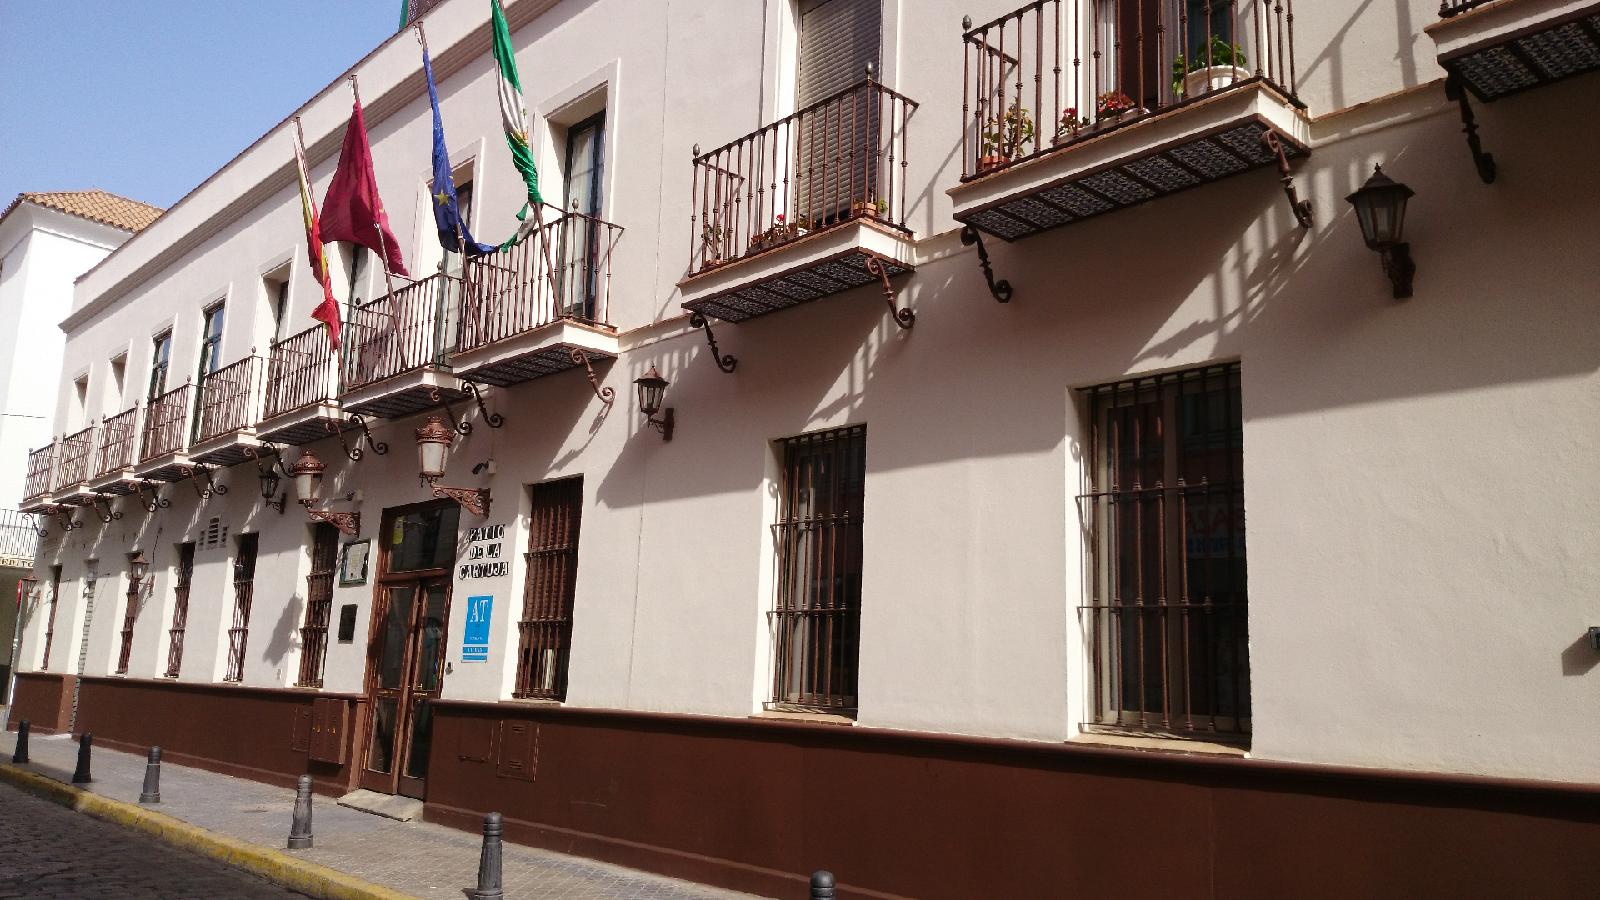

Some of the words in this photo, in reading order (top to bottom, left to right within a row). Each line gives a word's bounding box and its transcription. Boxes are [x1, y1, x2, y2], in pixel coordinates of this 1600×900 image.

[469, 525, 505, 542] PATIO
[470, 546, 484, 560] DE
[487, 543, 502, 559] LA
[459, 562, 509, 580] CARTUJA
[470, 600, 489, 622] AT
